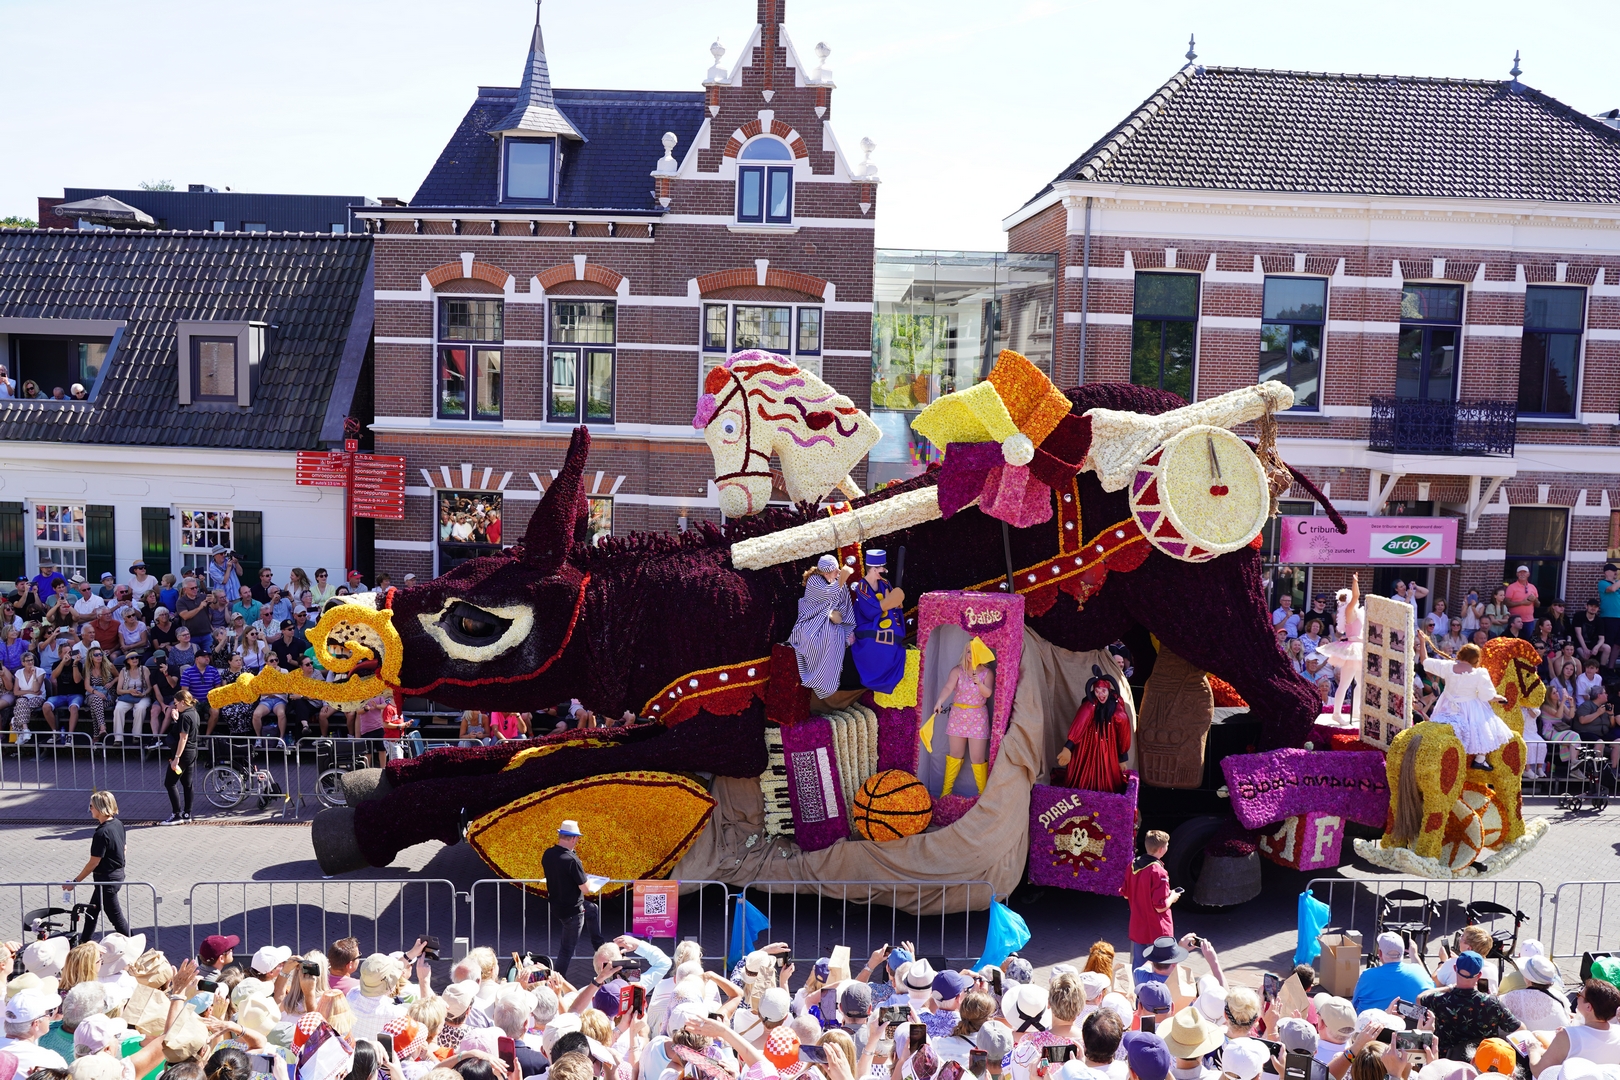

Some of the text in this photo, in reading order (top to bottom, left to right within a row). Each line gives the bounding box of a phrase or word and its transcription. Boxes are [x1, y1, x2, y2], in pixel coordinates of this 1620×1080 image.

[1297, 521, 1308, 534] C
[1388, 538, 1420, 549] ardo
[965, 606, 1003, 628] Barbie
[1038, 794, 1082, 829] DIABLE
[1310, 816, 1341, 862] F
